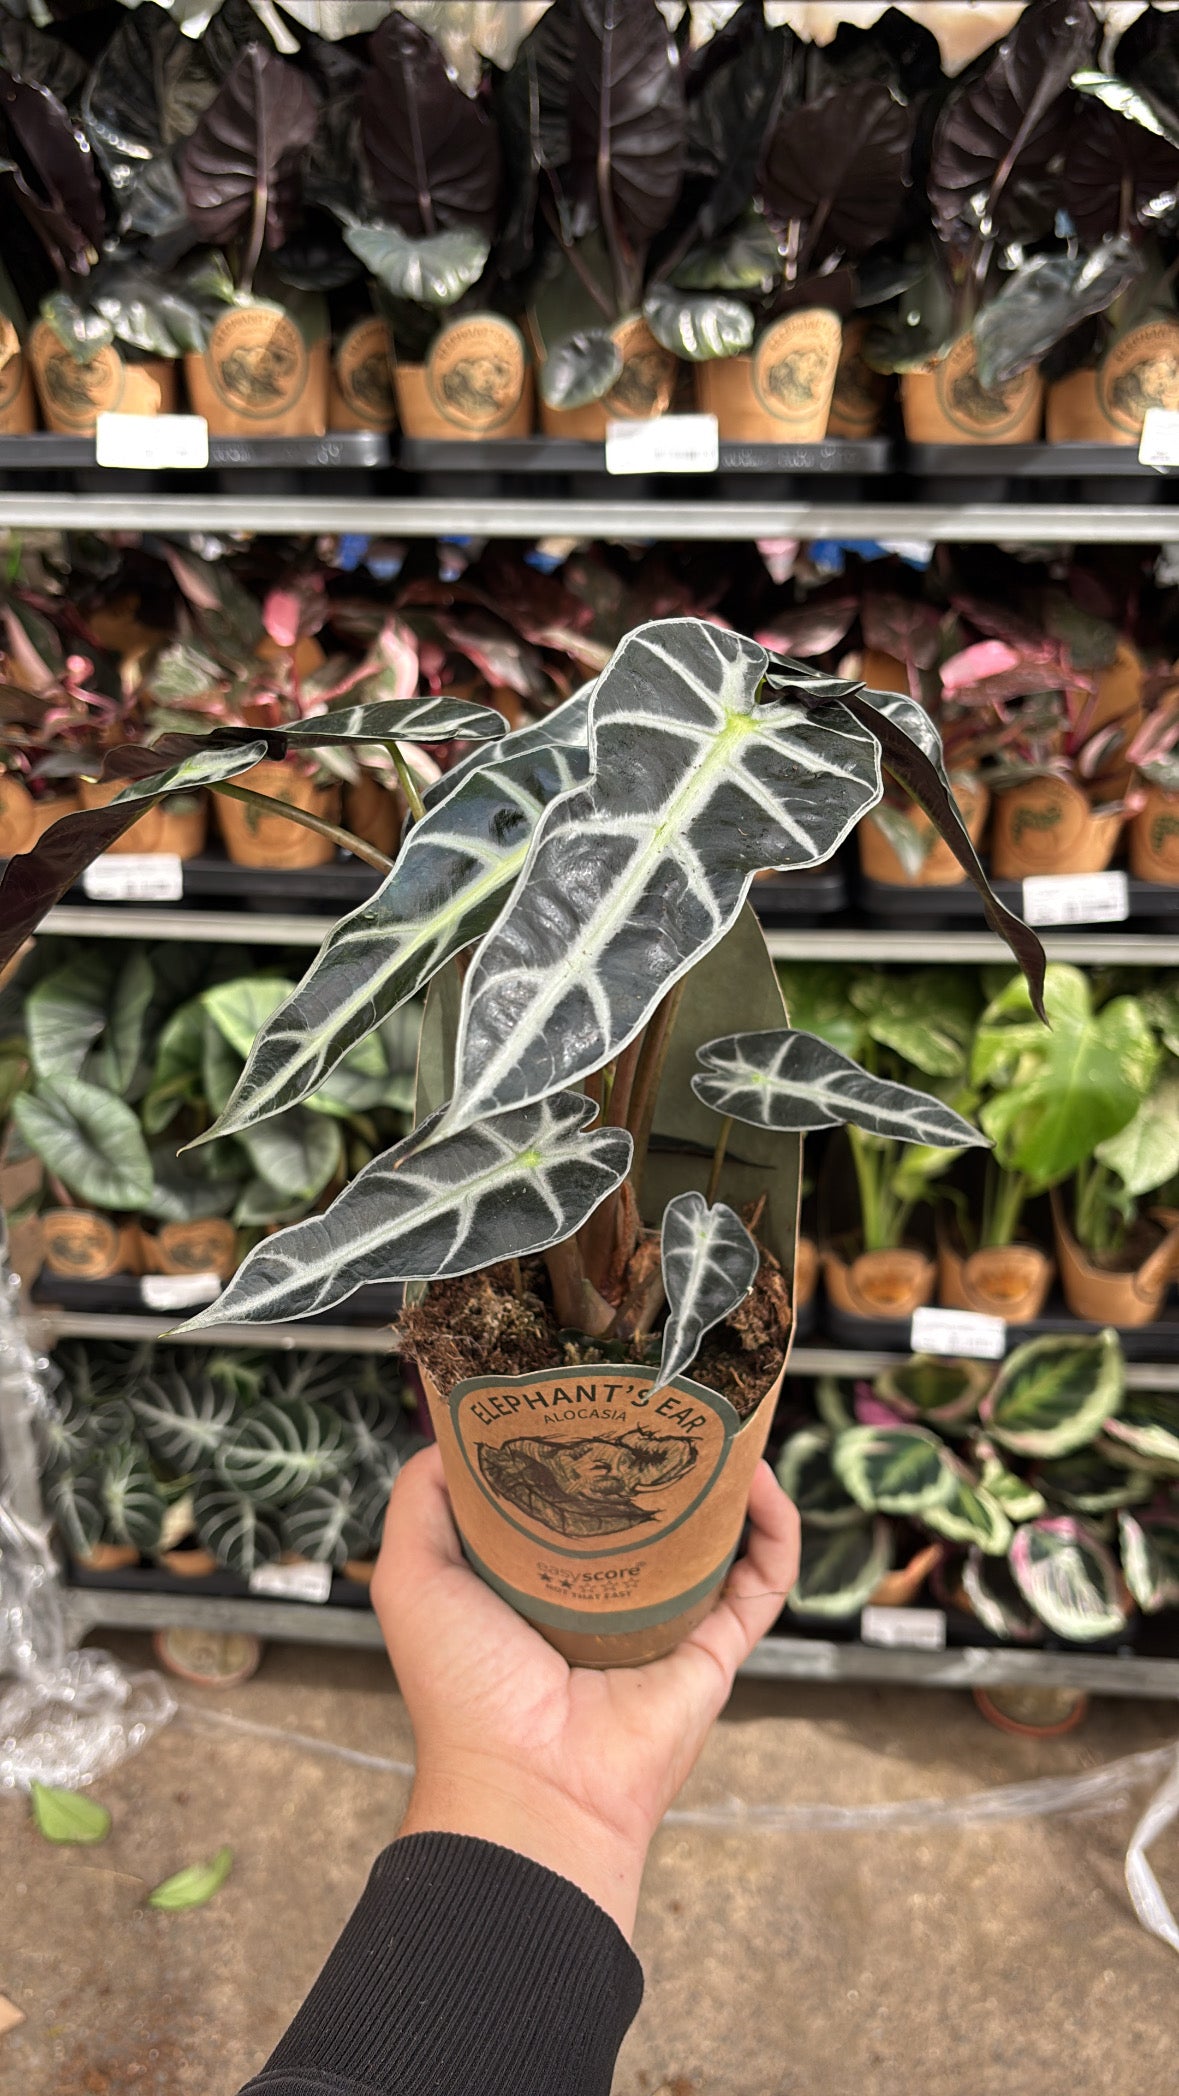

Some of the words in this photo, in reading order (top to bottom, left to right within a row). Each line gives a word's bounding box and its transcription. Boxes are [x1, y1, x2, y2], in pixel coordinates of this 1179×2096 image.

[470, 1384, 650, 1426] ELEPHANT'S
[655, 1396, 707, 1434] EAR
[543, 1408, 627, 1424] ALOCASIA
